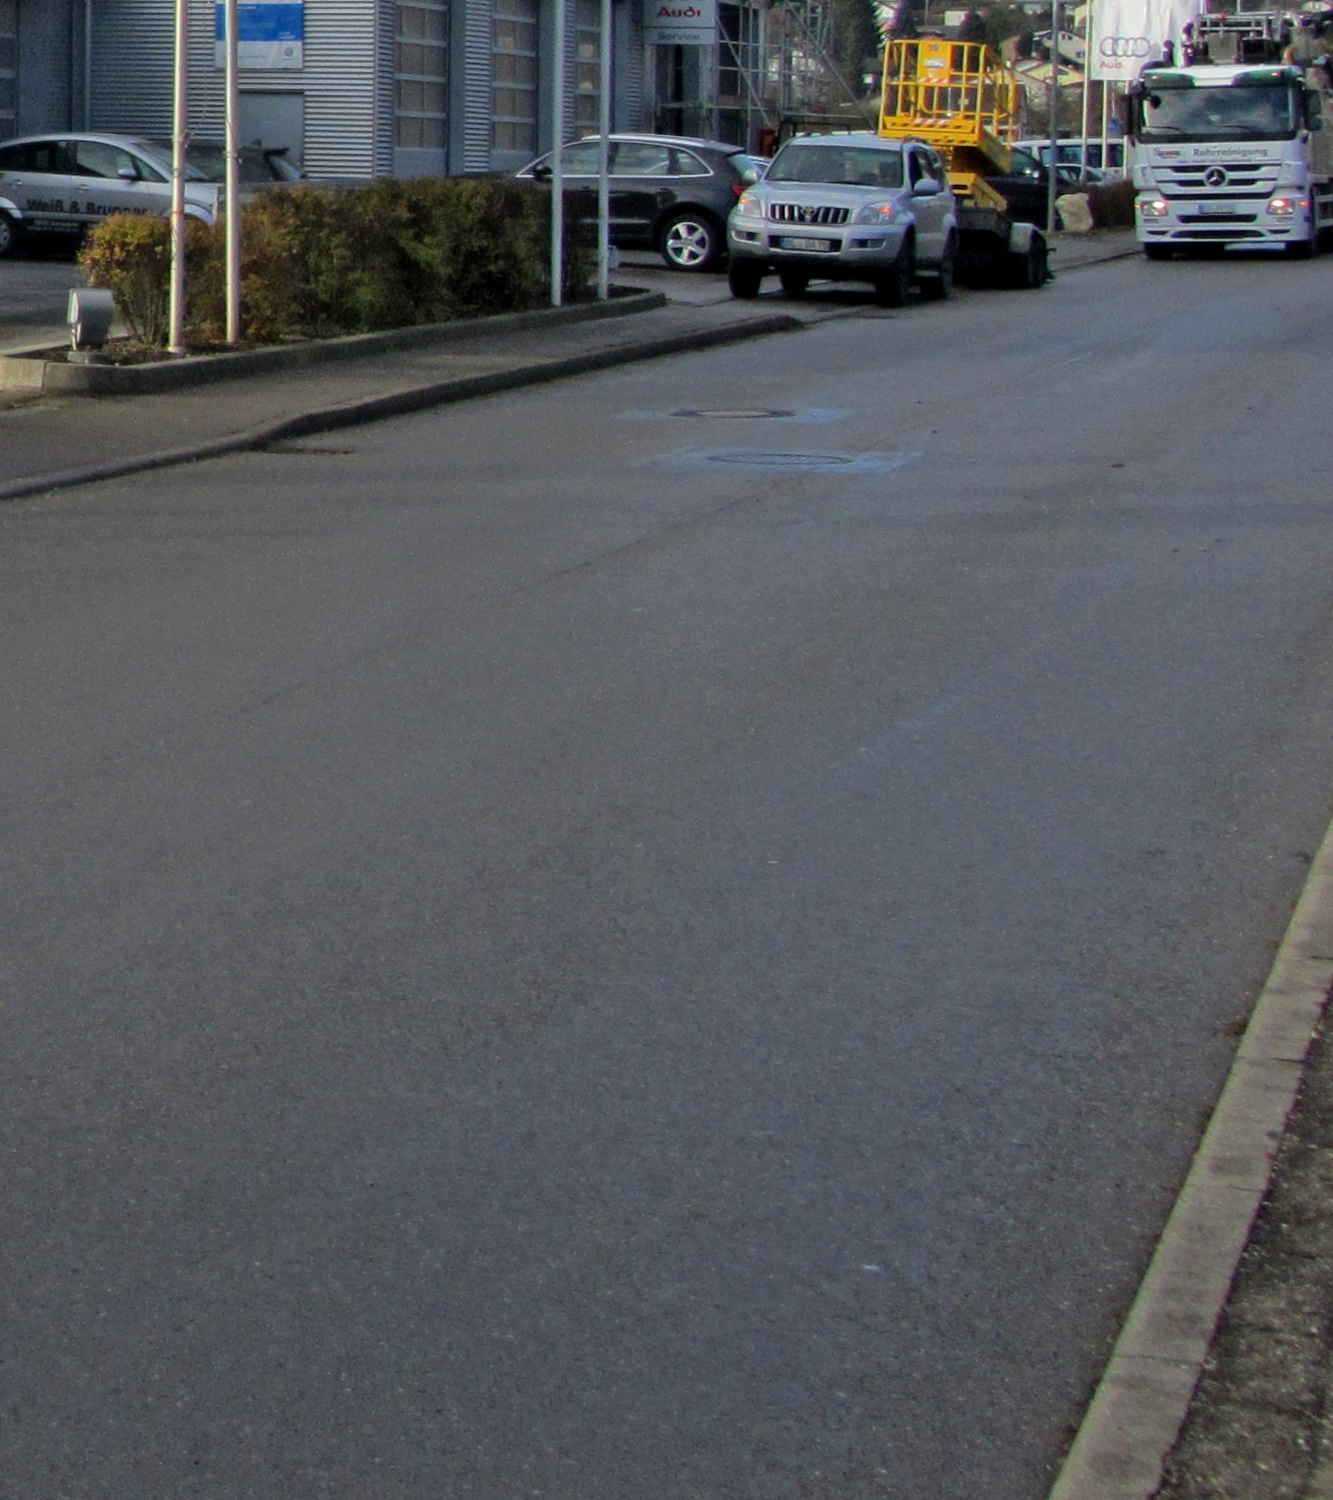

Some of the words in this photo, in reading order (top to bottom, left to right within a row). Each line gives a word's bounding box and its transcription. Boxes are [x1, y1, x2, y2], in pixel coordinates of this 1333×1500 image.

[657, 6, 701, 18] Audi
[1193, 147, 1268, 157] Rohrreinigung
[26, 198, 64, 213] Weiß
[71, 200, 80, 213] &
